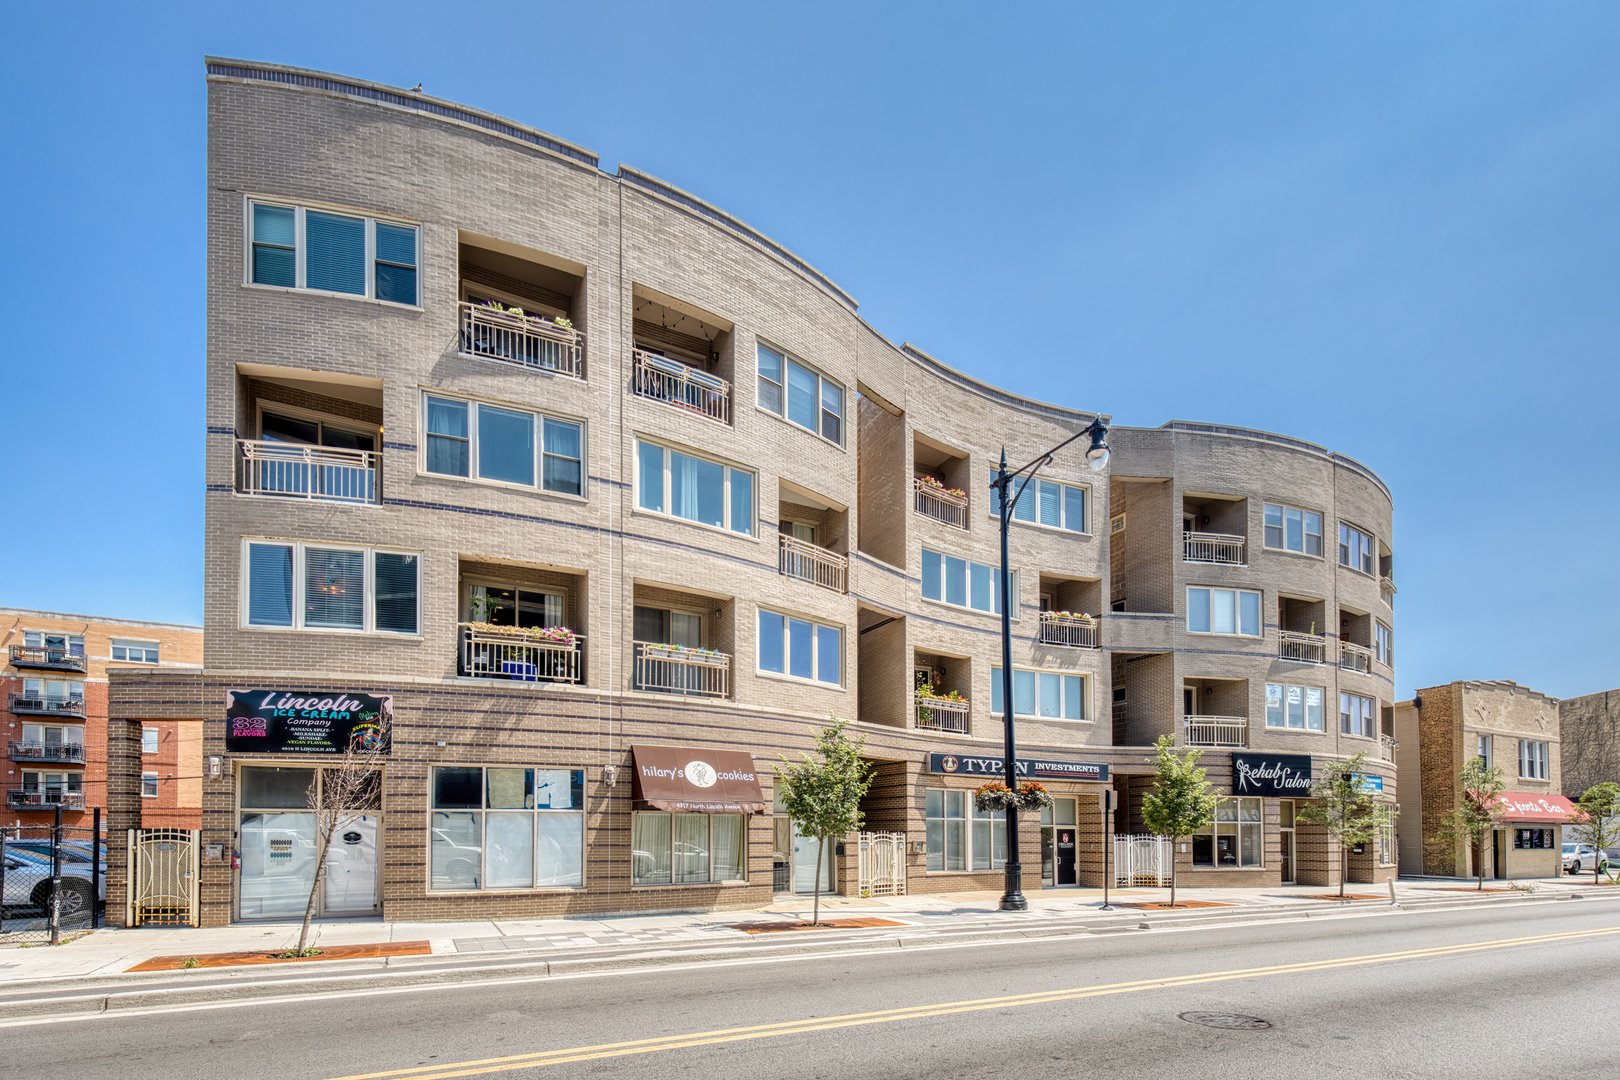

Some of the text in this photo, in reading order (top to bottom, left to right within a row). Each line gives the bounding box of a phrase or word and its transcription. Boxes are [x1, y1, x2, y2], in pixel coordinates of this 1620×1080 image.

[259, 692, 363, 712] Lincoln
[273, 708, 350, 720] ICE CREAM
[287, 717, 331, 727] Company
[232, 716, 267, 730] 32
[642, 765, 754, 781] hilary's cookies
[962, 758, 1100, 774] TYPN INVESTMENTS
[1273, 767, 1312, 789] Salon
[1501, 797, 1565, 815] Sports Bar
